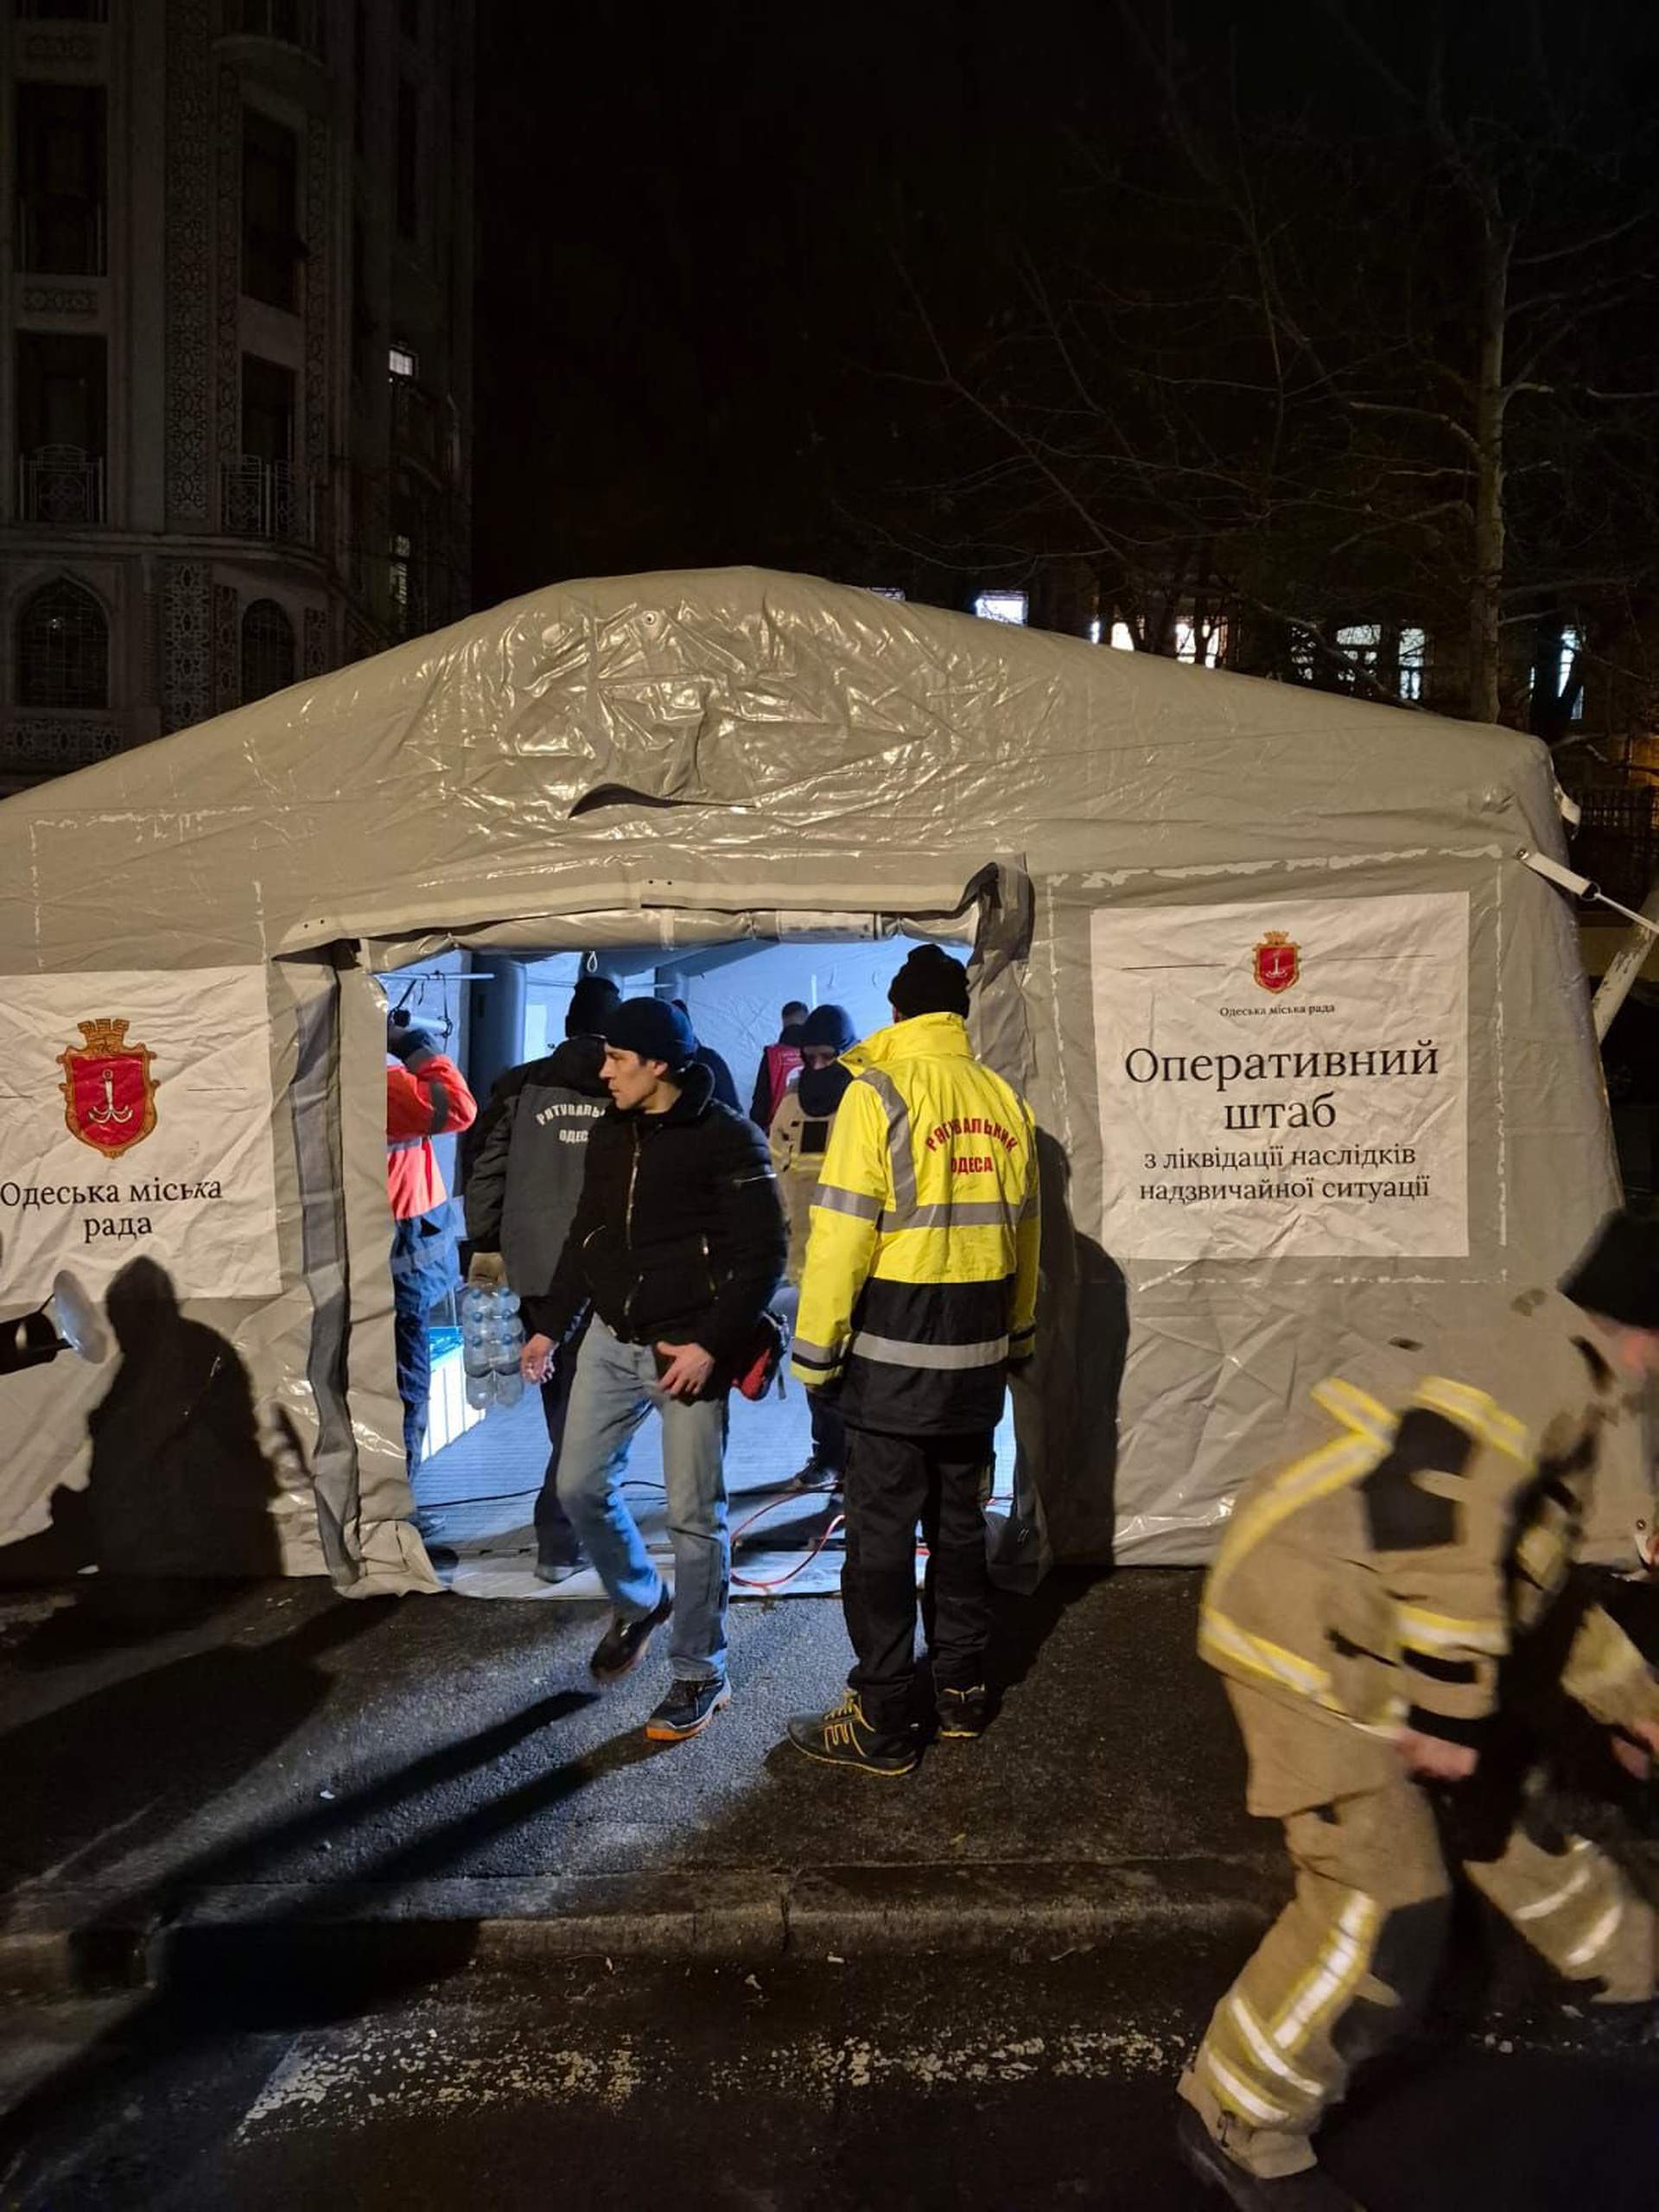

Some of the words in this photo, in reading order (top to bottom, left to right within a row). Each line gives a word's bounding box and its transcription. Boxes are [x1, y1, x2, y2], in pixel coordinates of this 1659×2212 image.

[1219, 1006, 1266, 1017] Одеська
[1268, 1003, 1306, 1015] міська
[1309, 1004, 1335, 1016] рада
[1125, 1039, 1439, 1091] Оперативний
[536, 1103, 606, 1125] РЯТУВАЛЬ
[1224, 1091, 1336, 1130] штаб
[559, 1129, 588, 1144] ОДЕС
[950, 1156, 994, 1175] ОДЕСА
[1144, 1152, 1156, 1169] з
[1164, 1147, 1284, 1169] ліквідації
[1292, 1144, 1416, 1167] наслідків
[0, 1182, 120, 1211] Одеська
[130, 1177, 222, 1202] міська
[1140, 1177, 1314, 1205] надзвичайної
[1322, 1175, 1430, 1204] ситуації
[84, 1216, 153, 1243] рада
